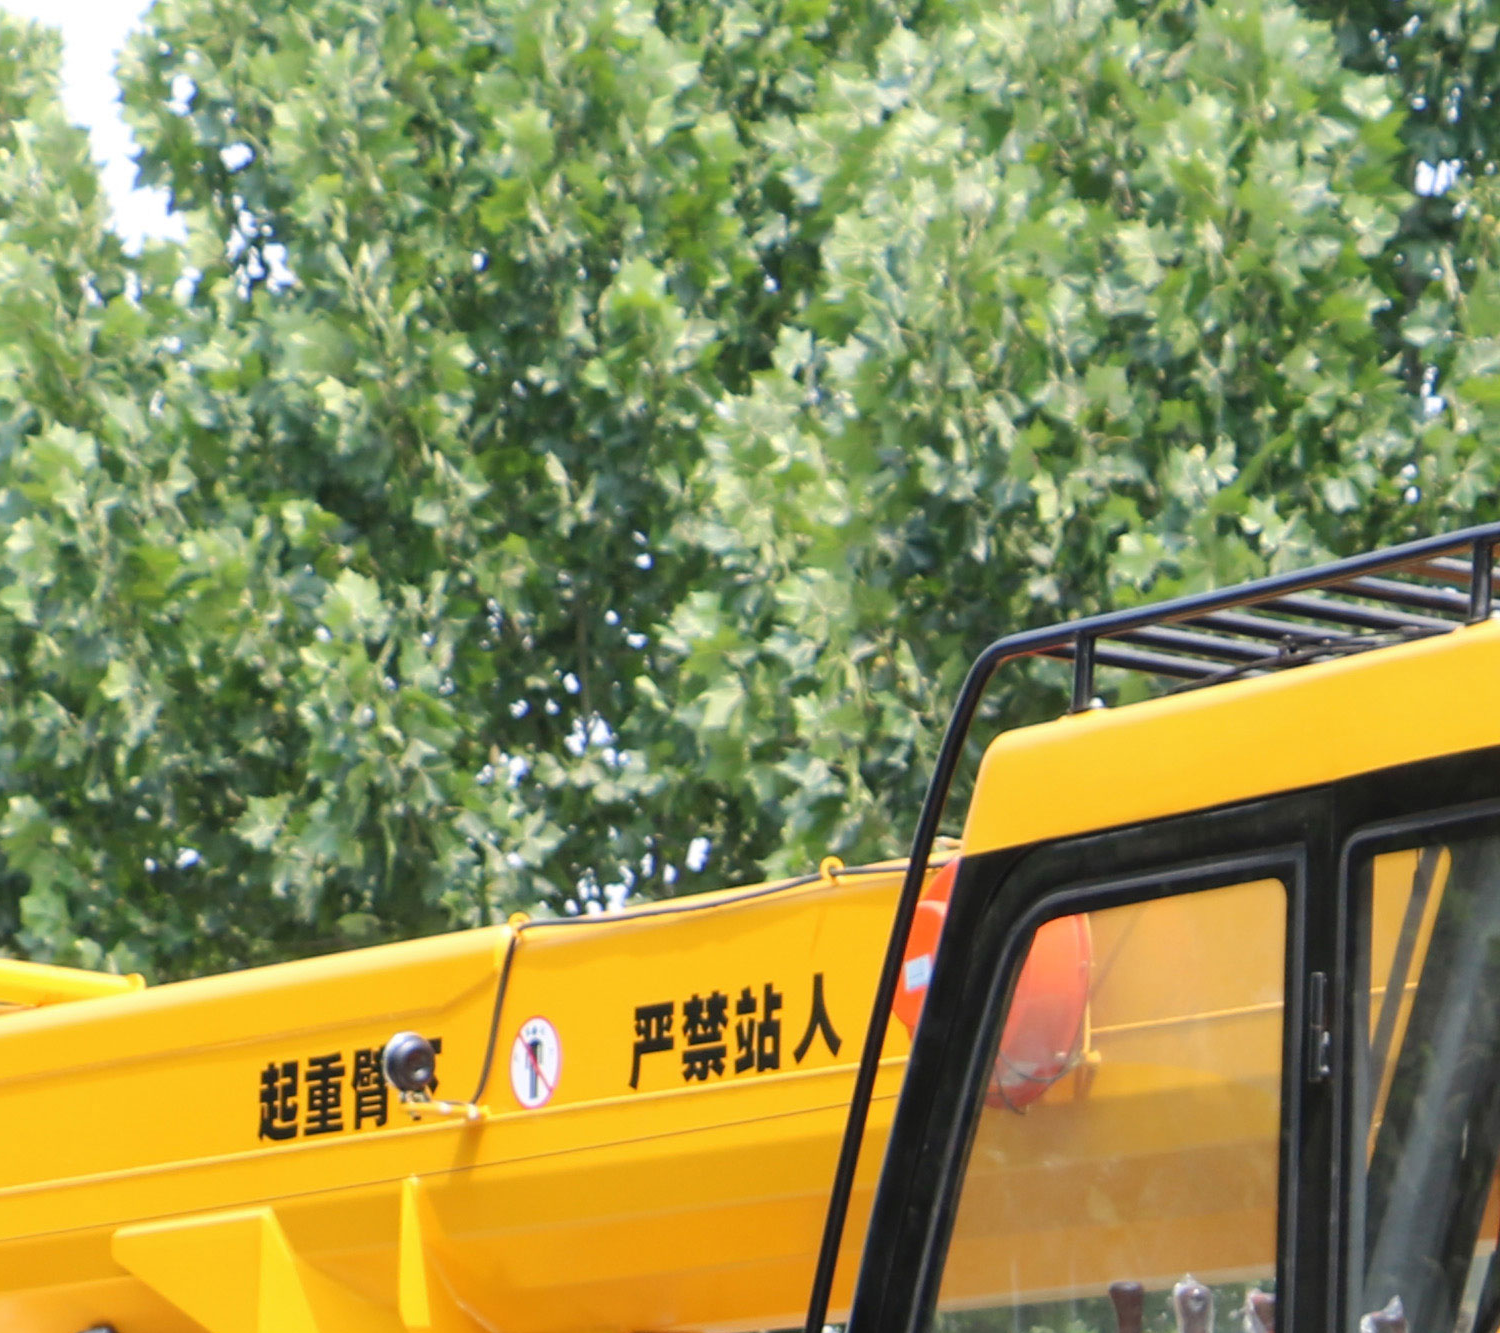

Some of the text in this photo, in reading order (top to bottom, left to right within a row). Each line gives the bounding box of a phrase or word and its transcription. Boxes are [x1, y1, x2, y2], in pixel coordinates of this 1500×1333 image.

[259, 973, 842, 1141] 起重臂 严禁站人
